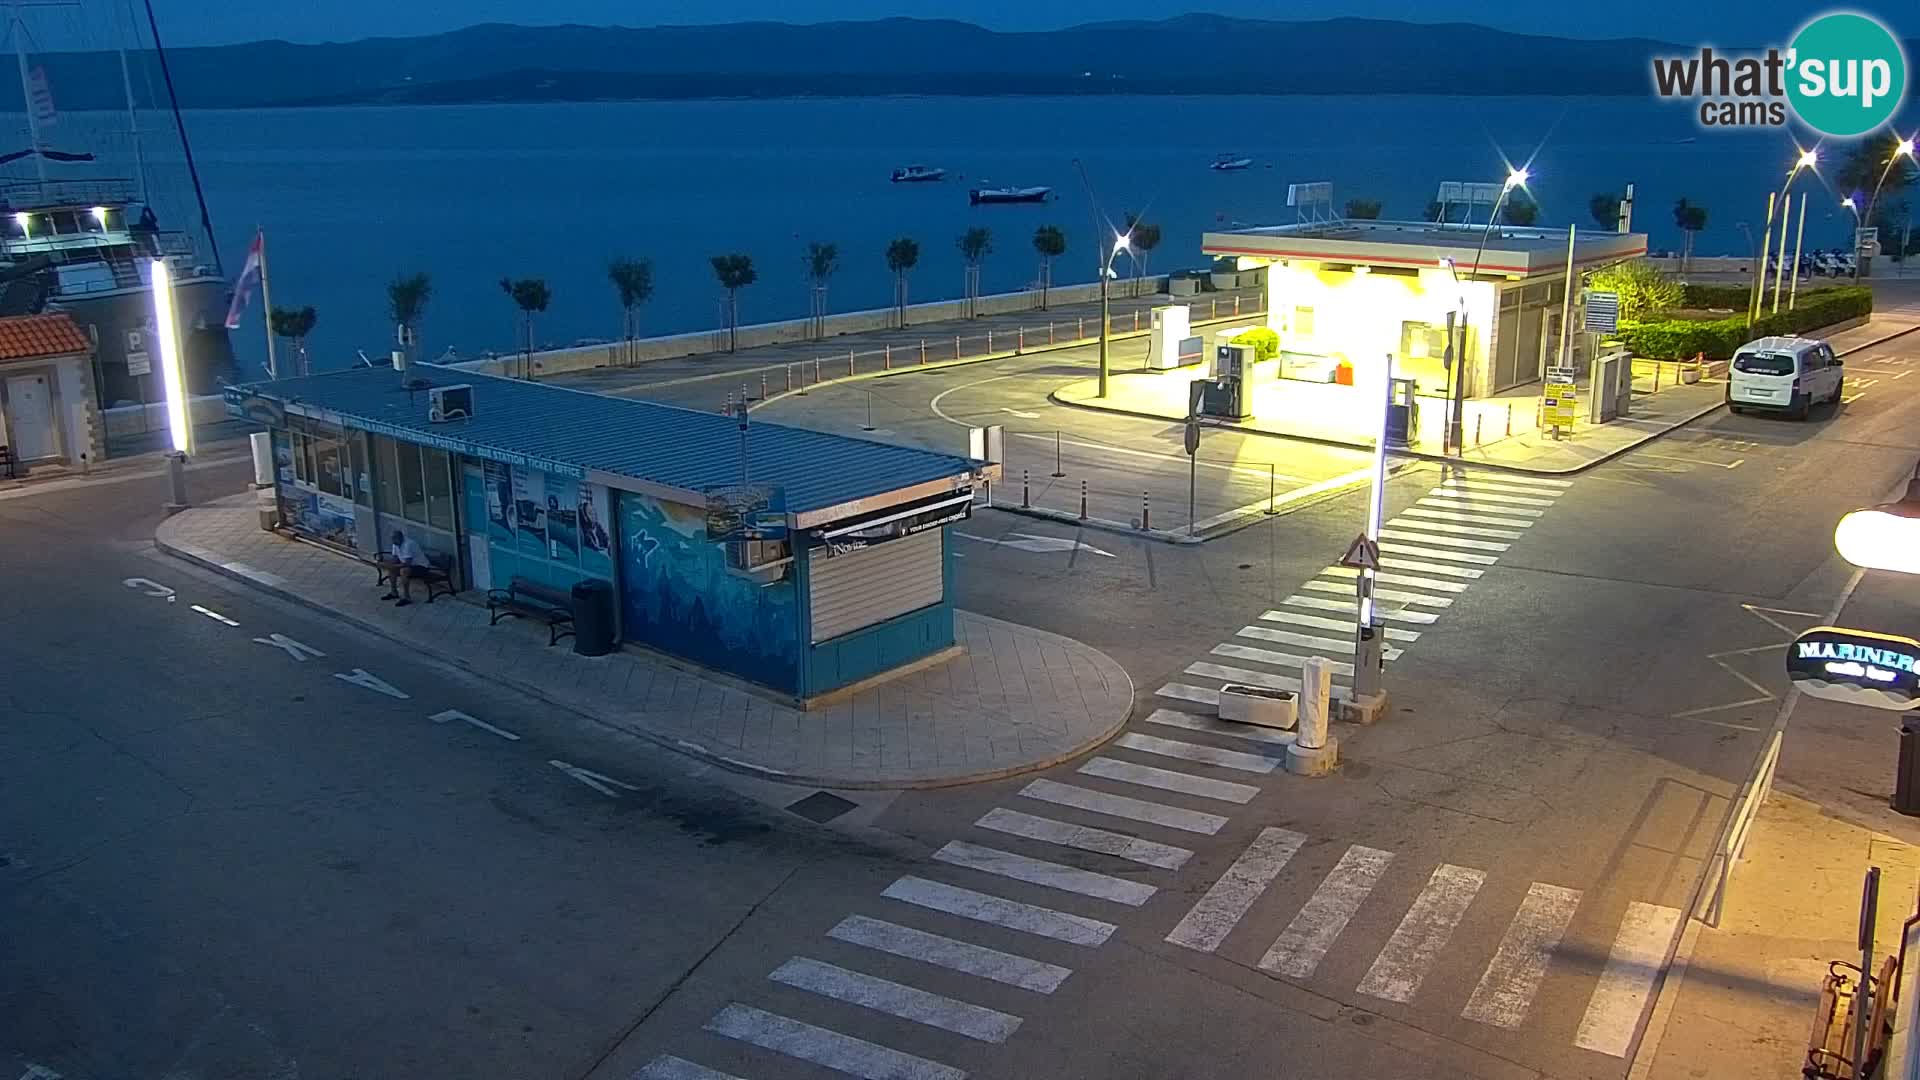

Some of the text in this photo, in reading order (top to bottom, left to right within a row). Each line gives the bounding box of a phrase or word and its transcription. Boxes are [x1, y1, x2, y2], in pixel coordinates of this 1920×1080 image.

[493, 451, 525, 465] STATION
[528, 458, 553, 472] TICKET
[553, 462, 581, 478] OFFICE
